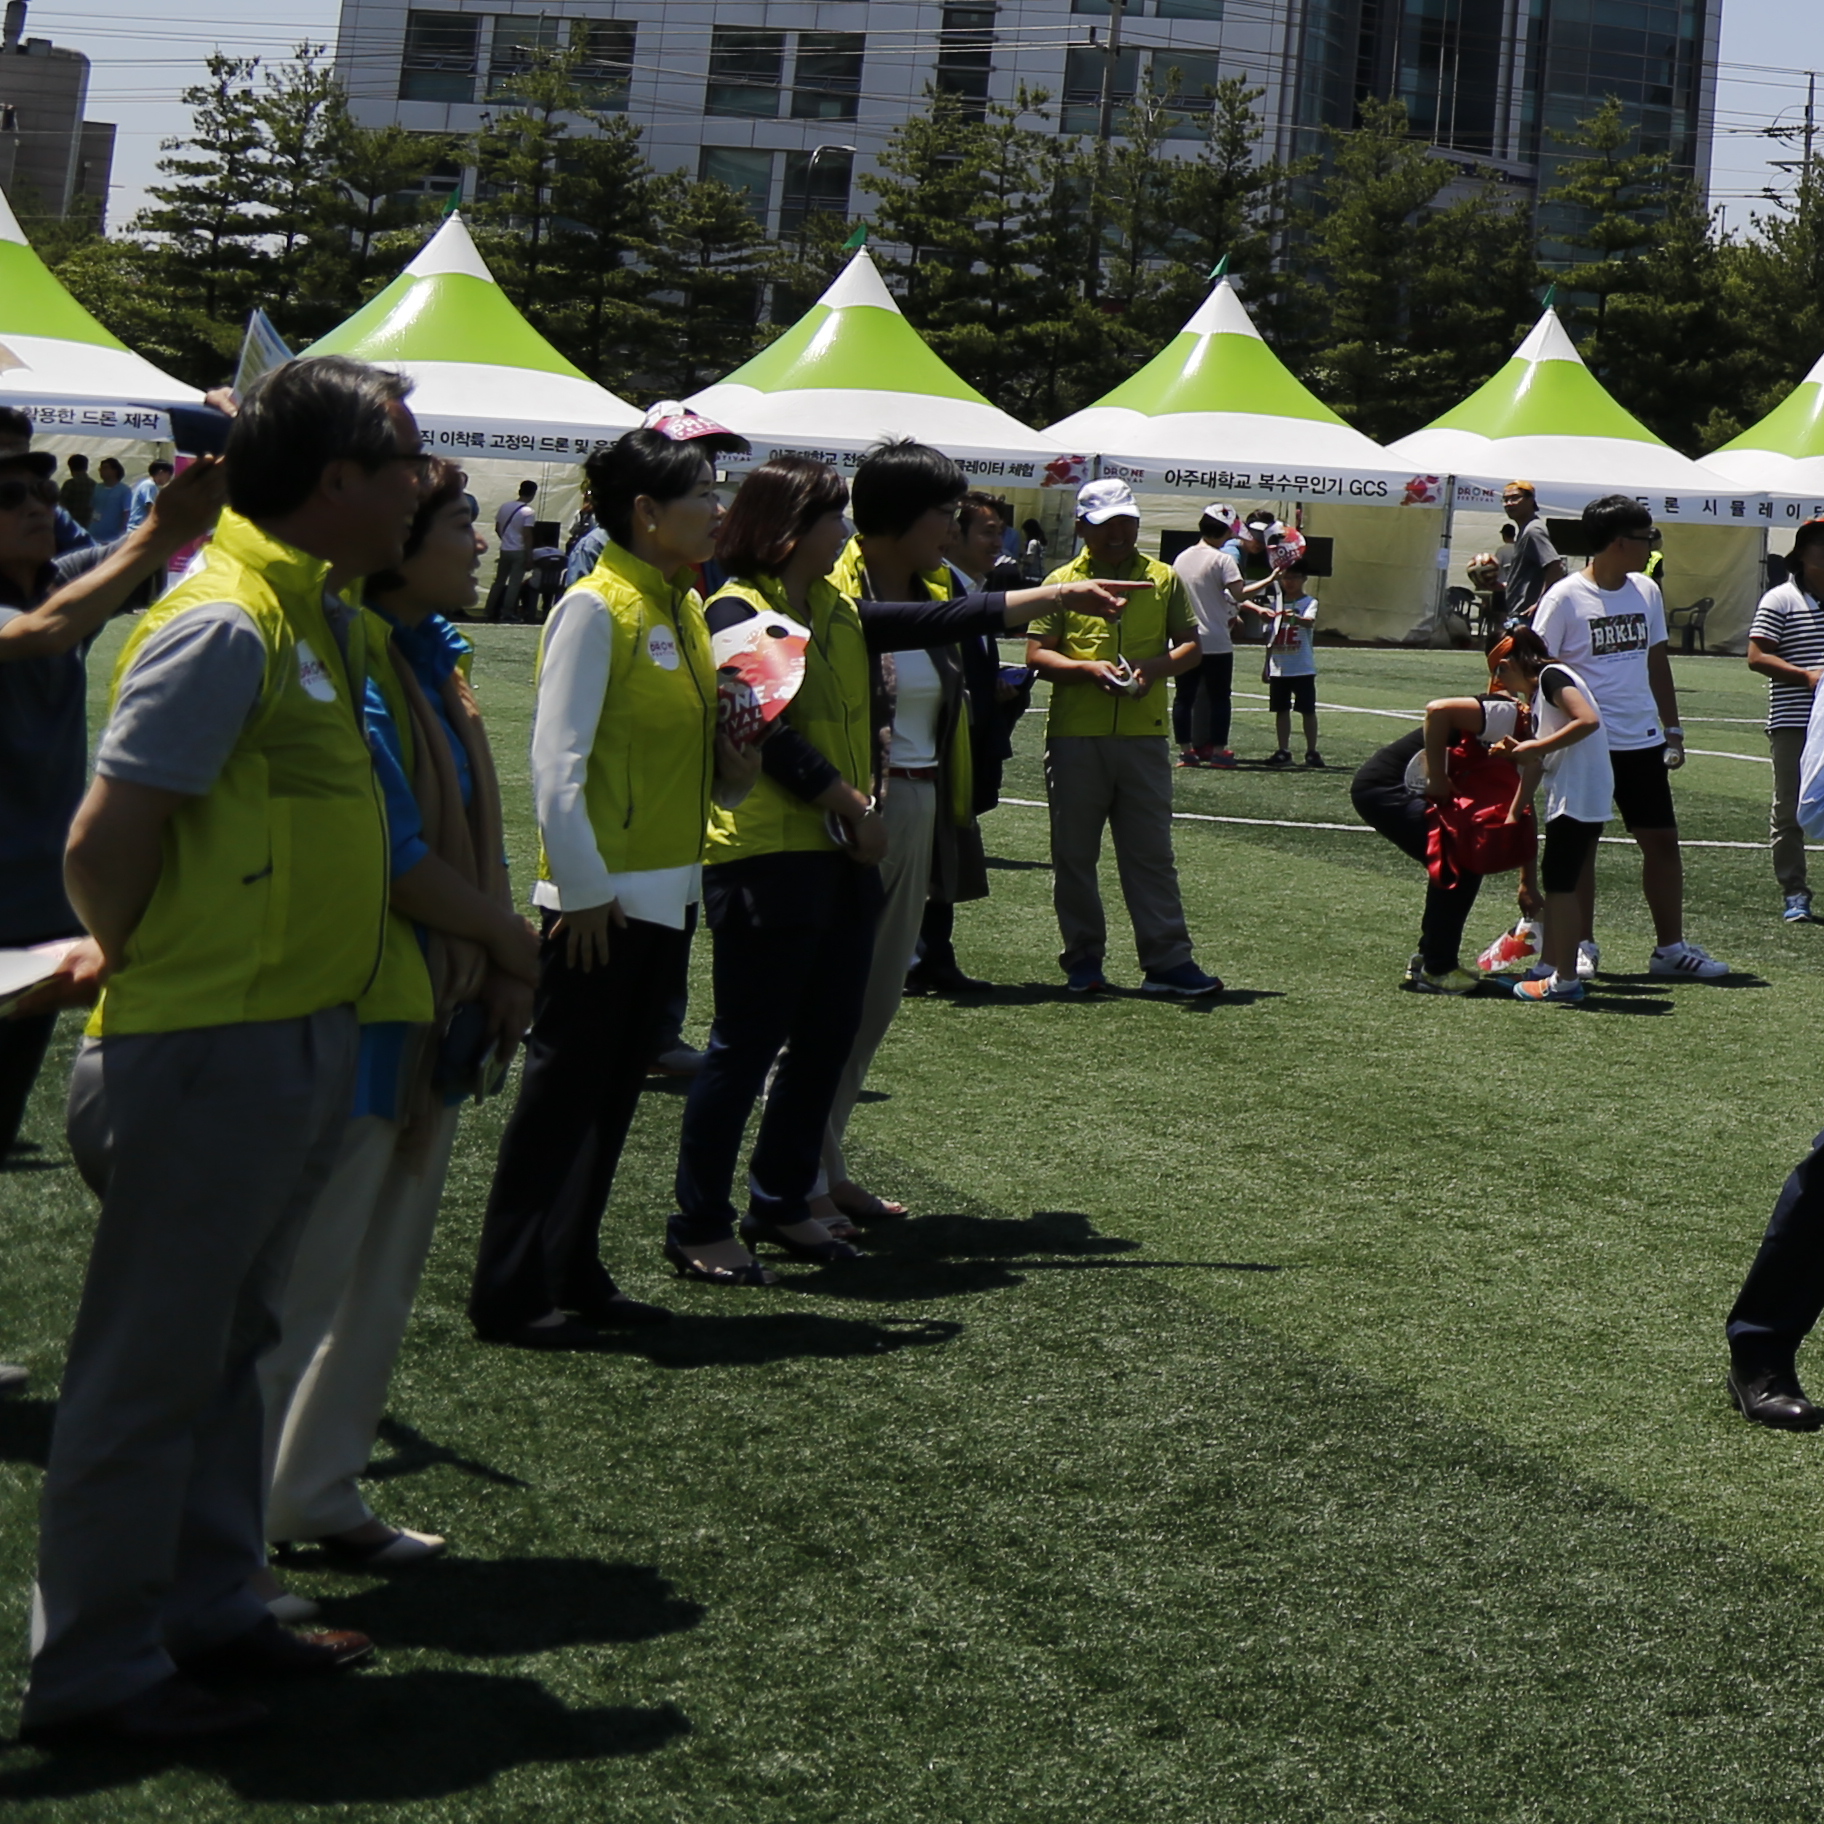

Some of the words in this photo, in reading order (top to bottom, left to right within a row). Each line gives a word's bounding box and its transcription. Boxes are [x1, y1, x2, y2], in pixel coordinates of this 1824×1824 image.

[80, 410, 118, 427] 드론
[124, 412, 161, 430] 제작
[440, 431, 486, 449] 이착륙
[490, 434, 536, 452] 고정익
[539, 437, 570, 454] 드론
[574, 439, 589, 455] 및
[1008, 463, 1035, 478] 체험
[1104, 466, 1144, 476] DRONE
[1164, 469, 1252, 490] 아주대학교
[1258, 474, 1343, 495] 복수무인기
[1350, 479, 1388, 497] GCS
[1457, 486, 1495, 496] DRONE
[1457, 495, 1495, 503] FESTIVAL
[1593, 622, 1647, 647] BRKLN
